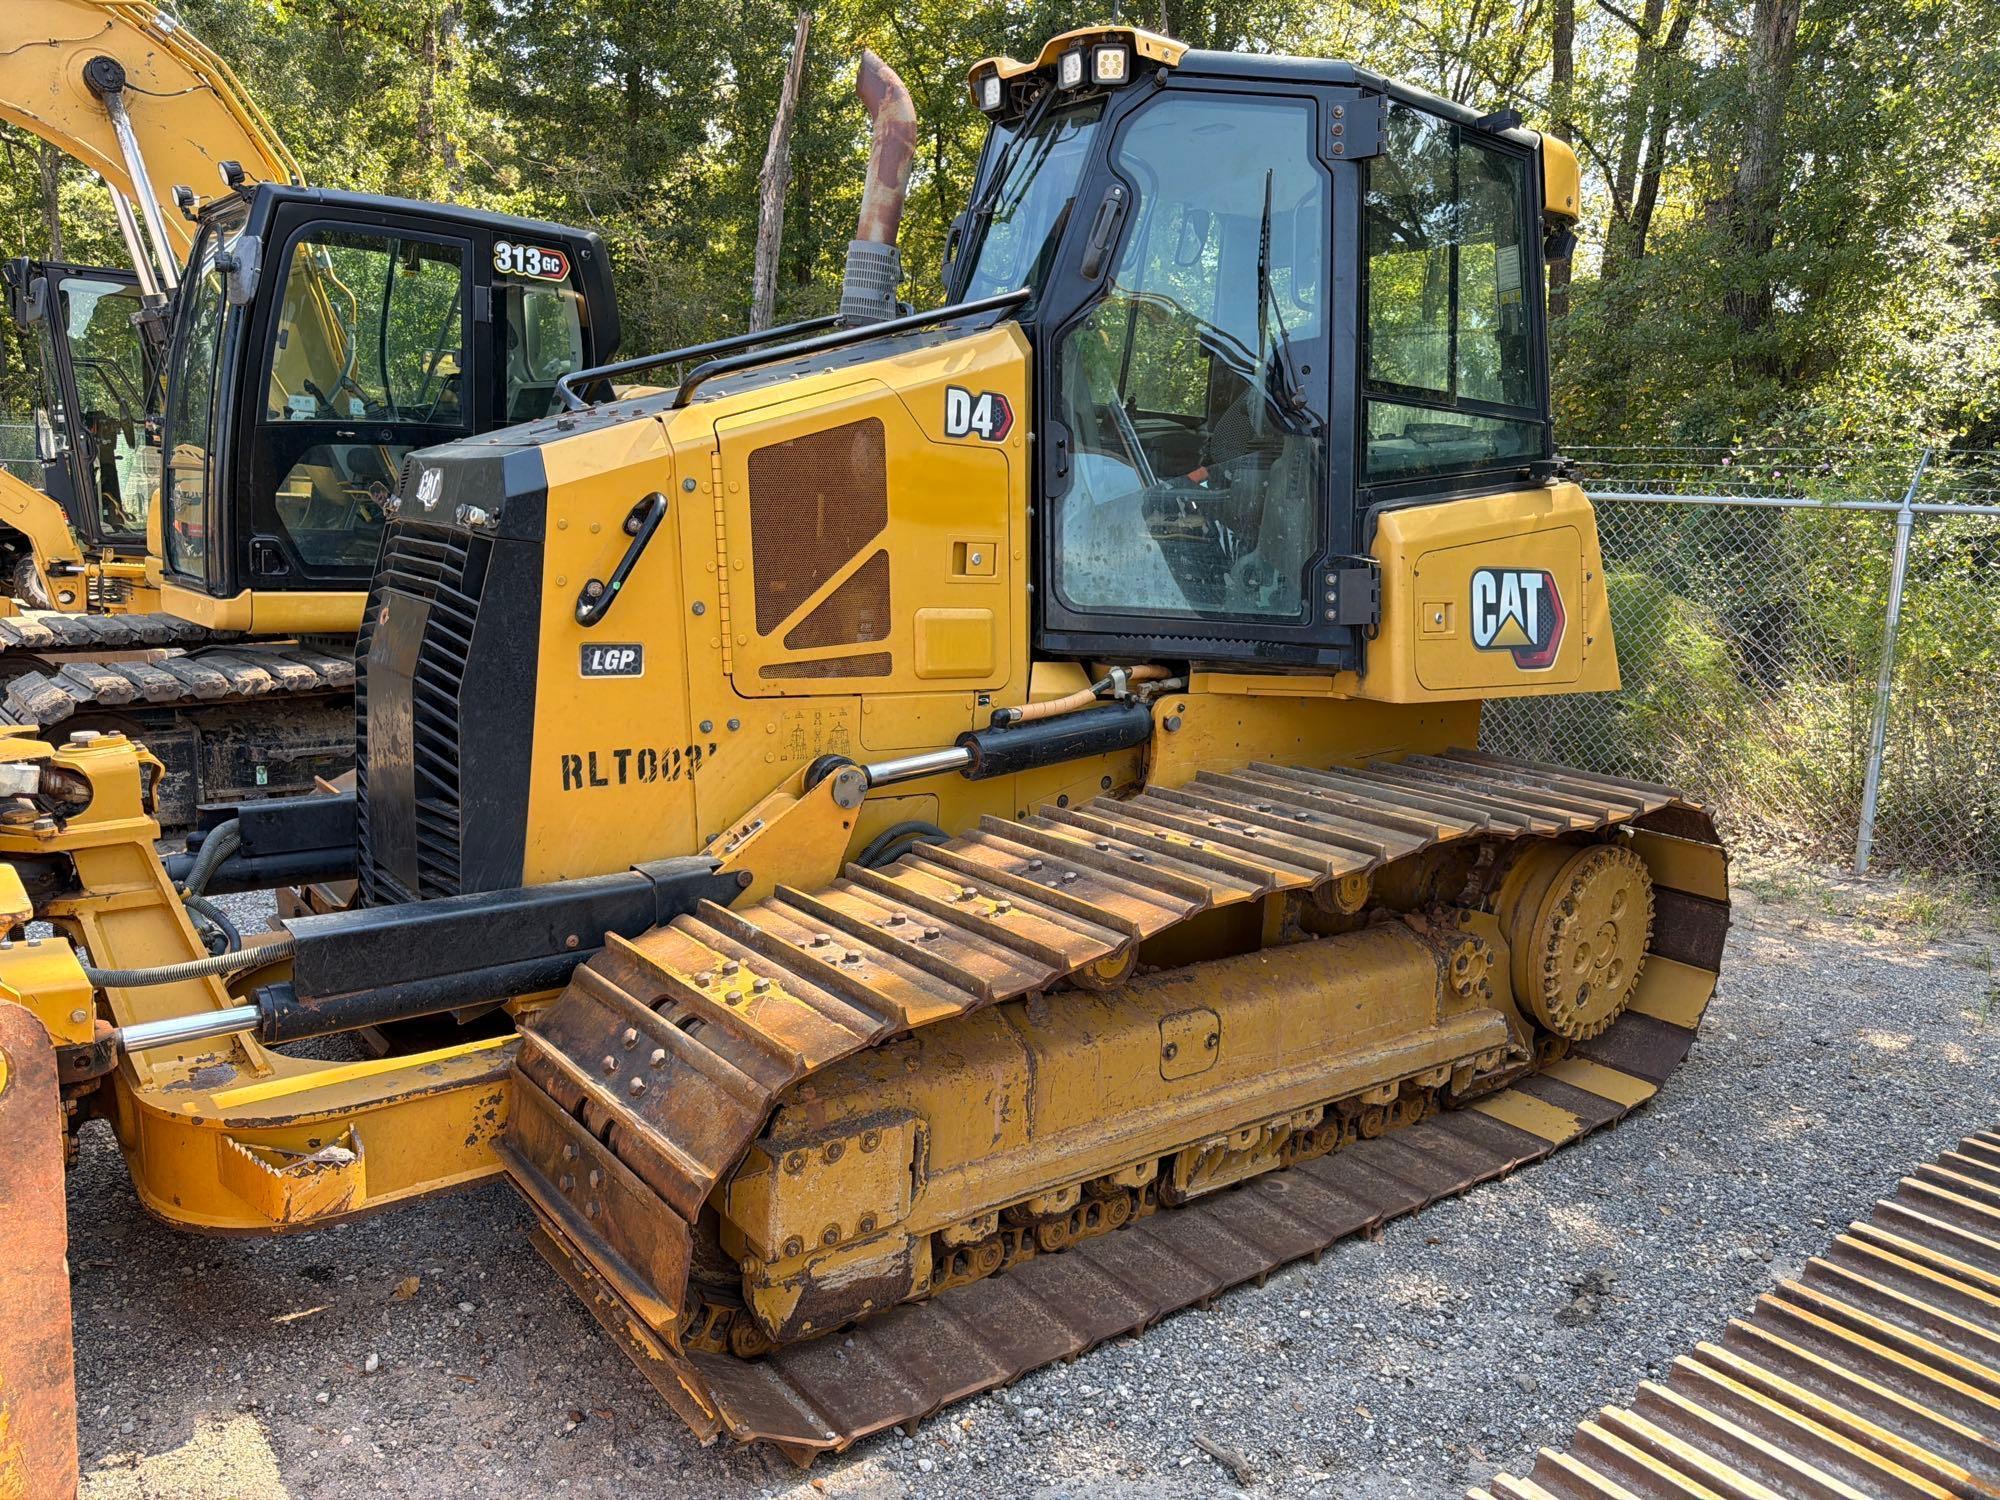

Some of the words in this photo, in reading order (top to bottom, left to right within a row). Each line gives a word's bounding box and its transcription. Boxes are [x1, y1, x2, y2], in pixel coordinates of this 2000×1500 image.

[947, 388, 993, 438] D4
[1472, 570, 1543, 647] CAT
[592, 650, 635, 670] LGP
